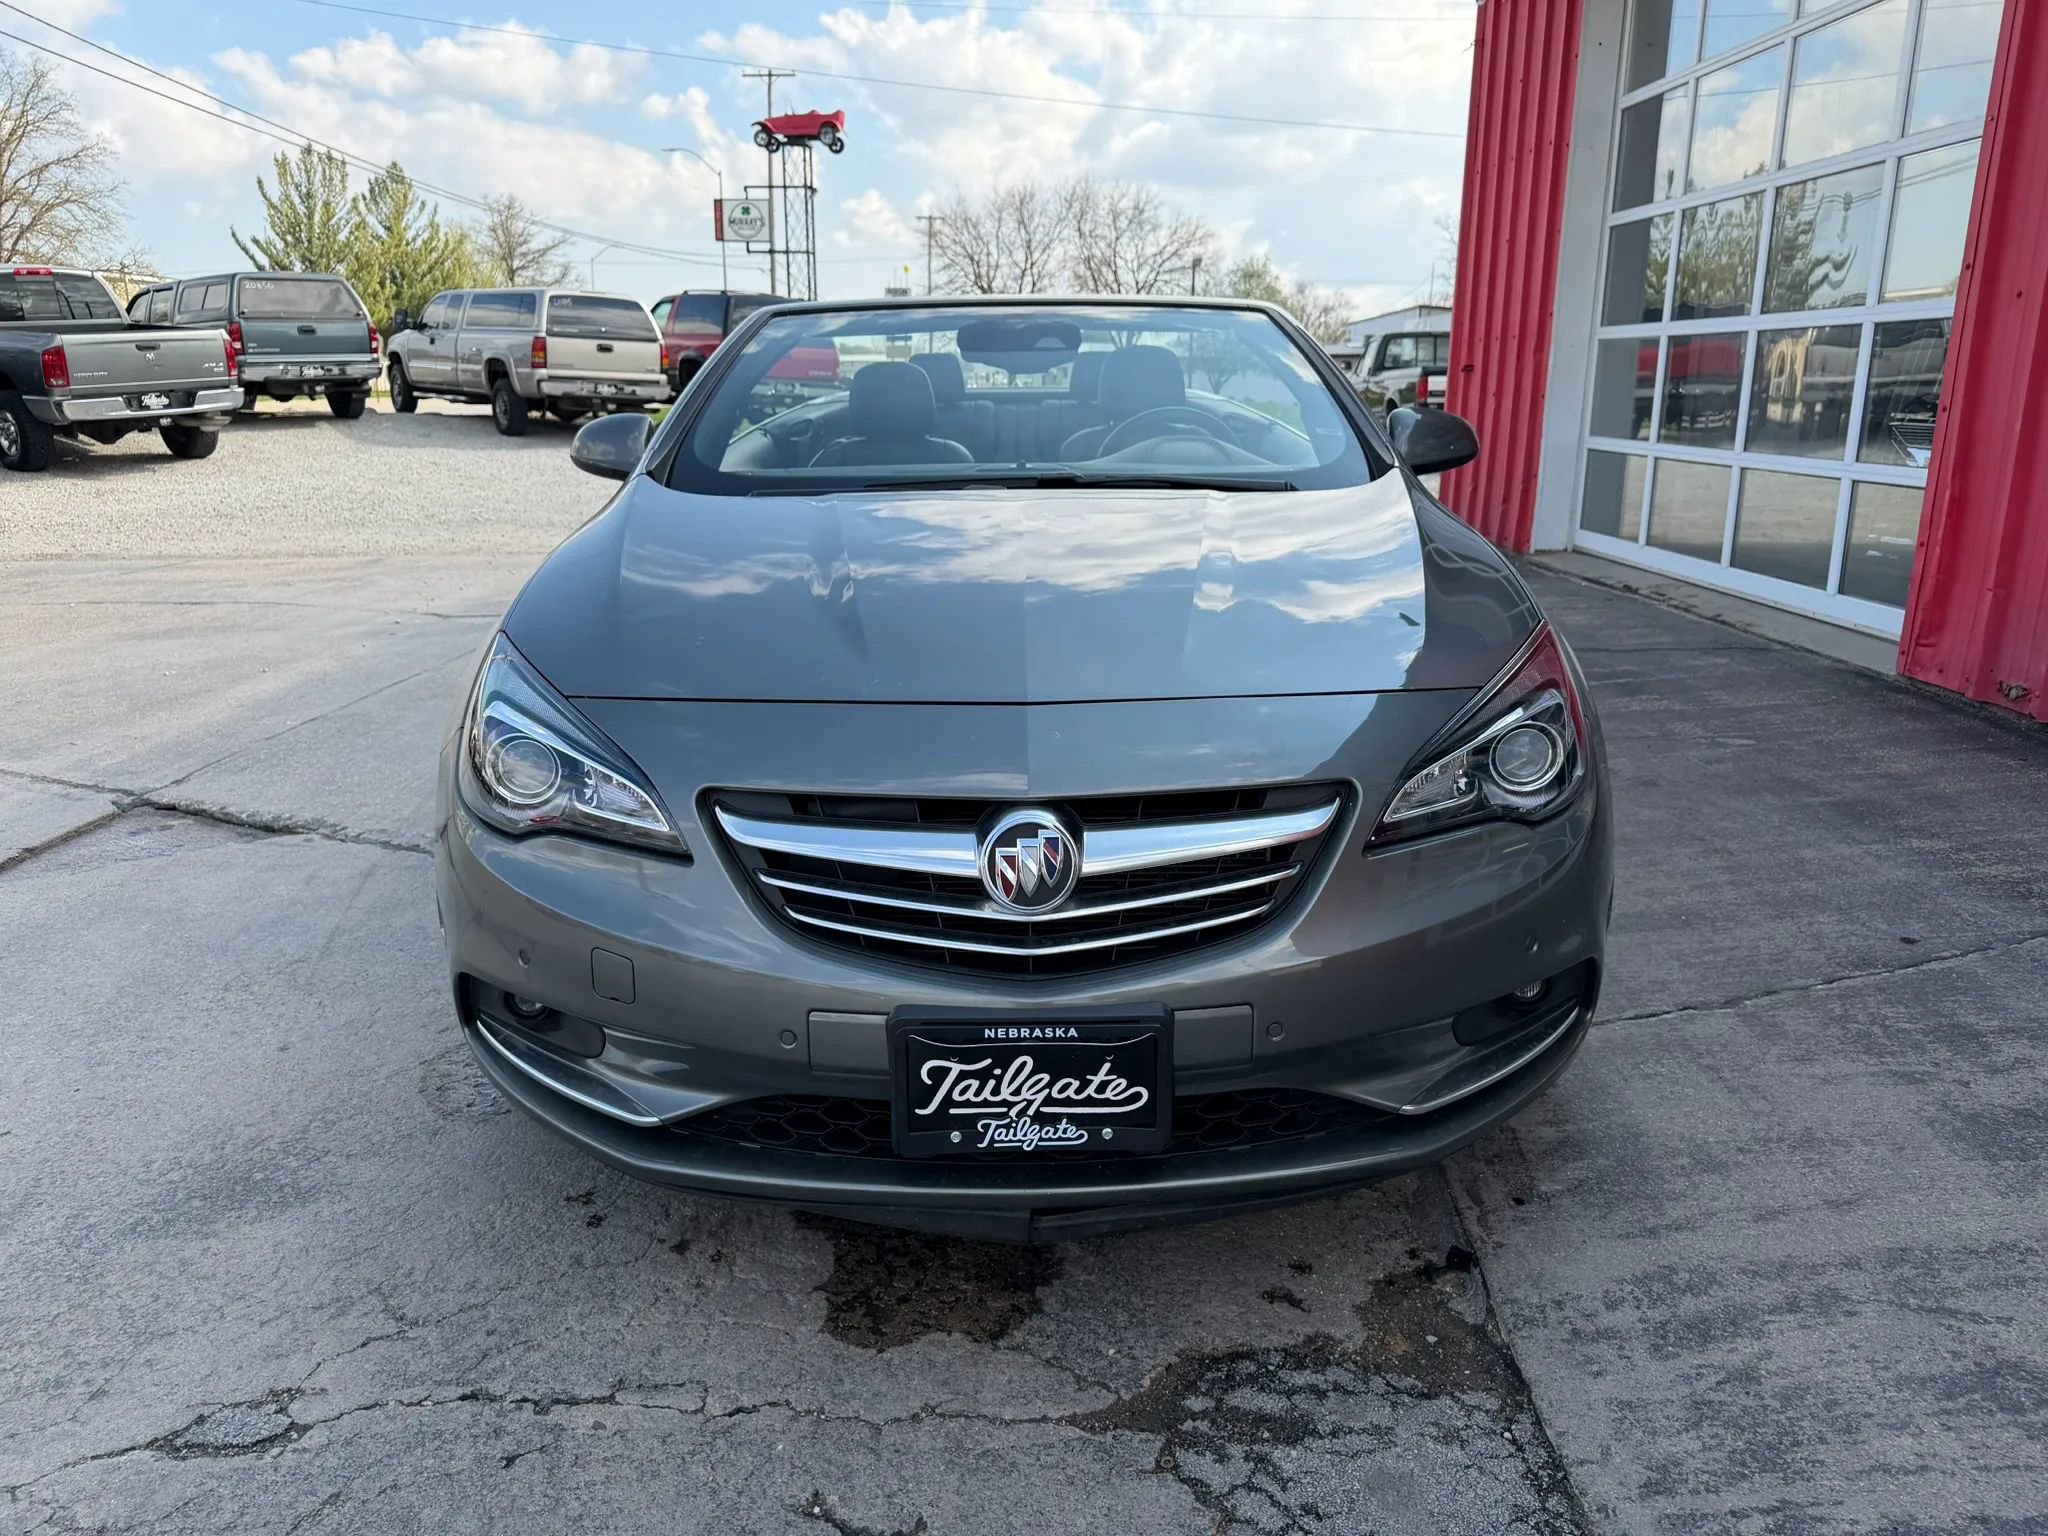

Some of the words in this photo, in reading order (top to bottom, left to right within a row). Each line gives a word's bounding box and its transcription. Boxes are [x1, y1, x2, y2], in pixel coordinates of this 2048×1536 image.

[984, 1027, 1079, 1038] NEBRASKA
[914, 1055, 1149, 1120] Tailgate
[977, 1117, 1088, 1151] Tailgate
